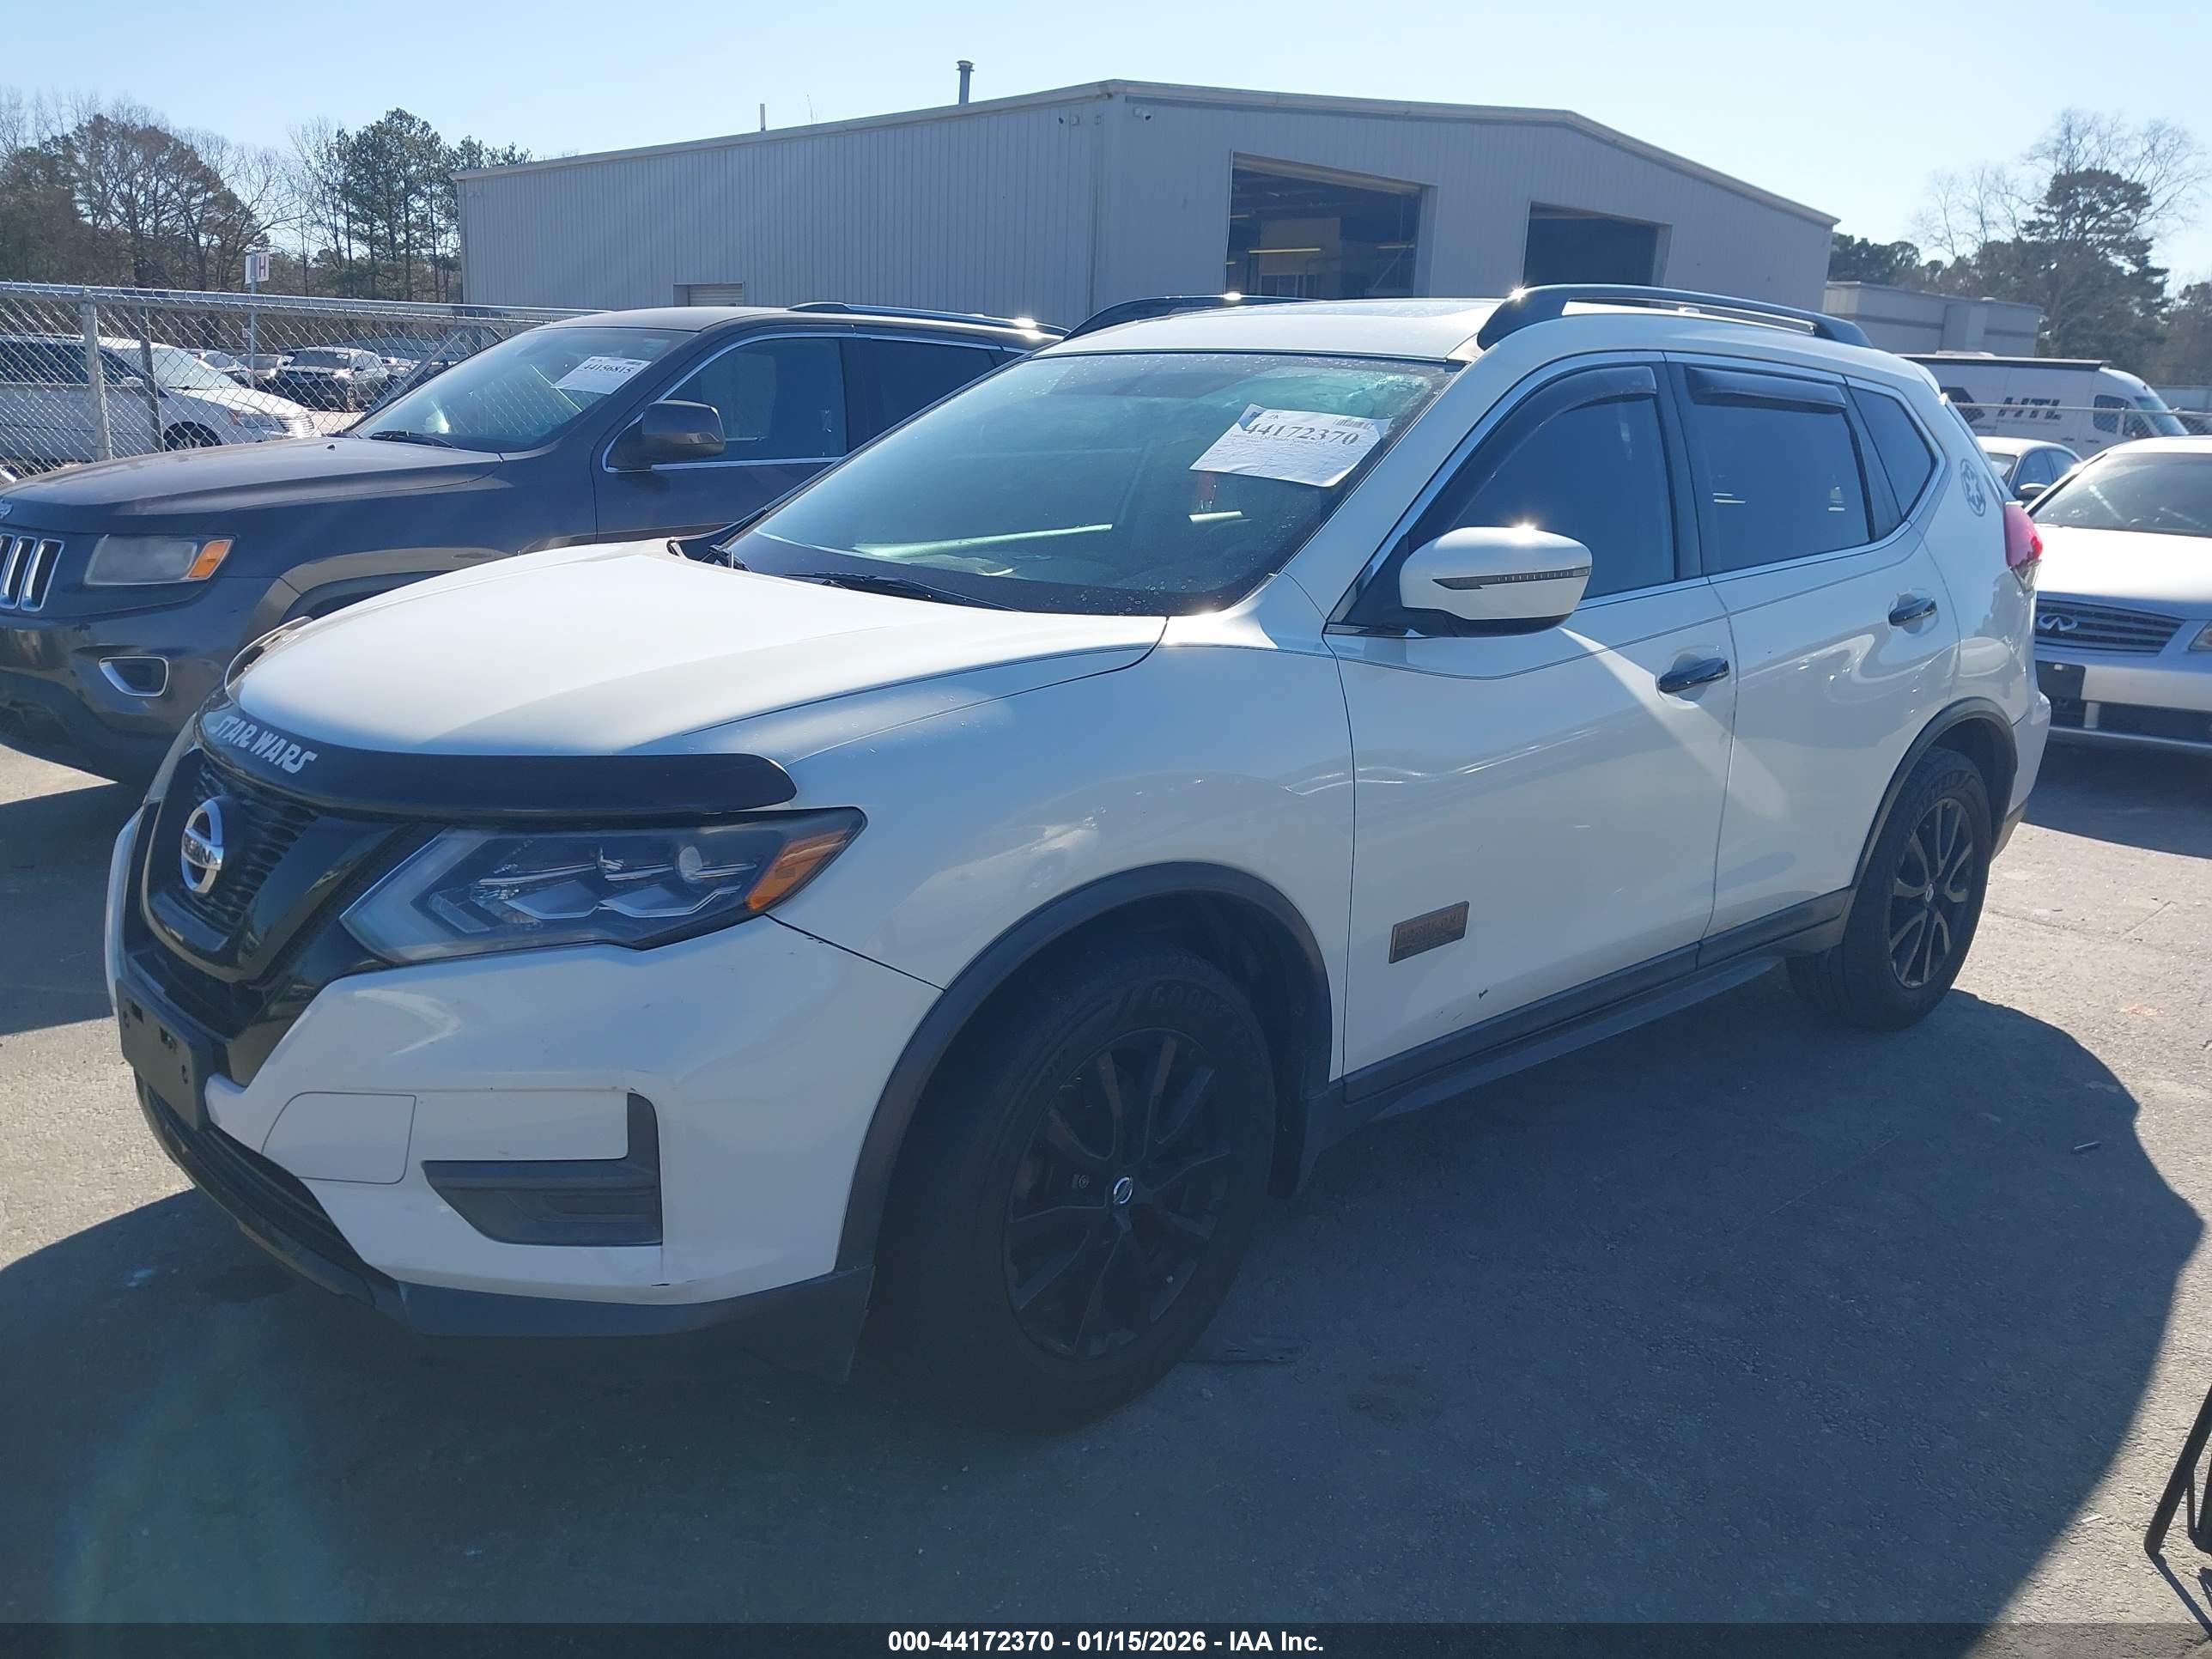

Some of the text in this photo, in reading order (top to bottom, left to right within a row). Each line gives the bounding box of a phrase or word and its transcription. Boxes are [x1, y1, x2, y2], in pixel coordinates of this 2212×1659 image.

[259, 254, 266, 278] H
[1243, 422, 1358, 446] 44172370
[210, 714, 318, 774] STAR WARS
